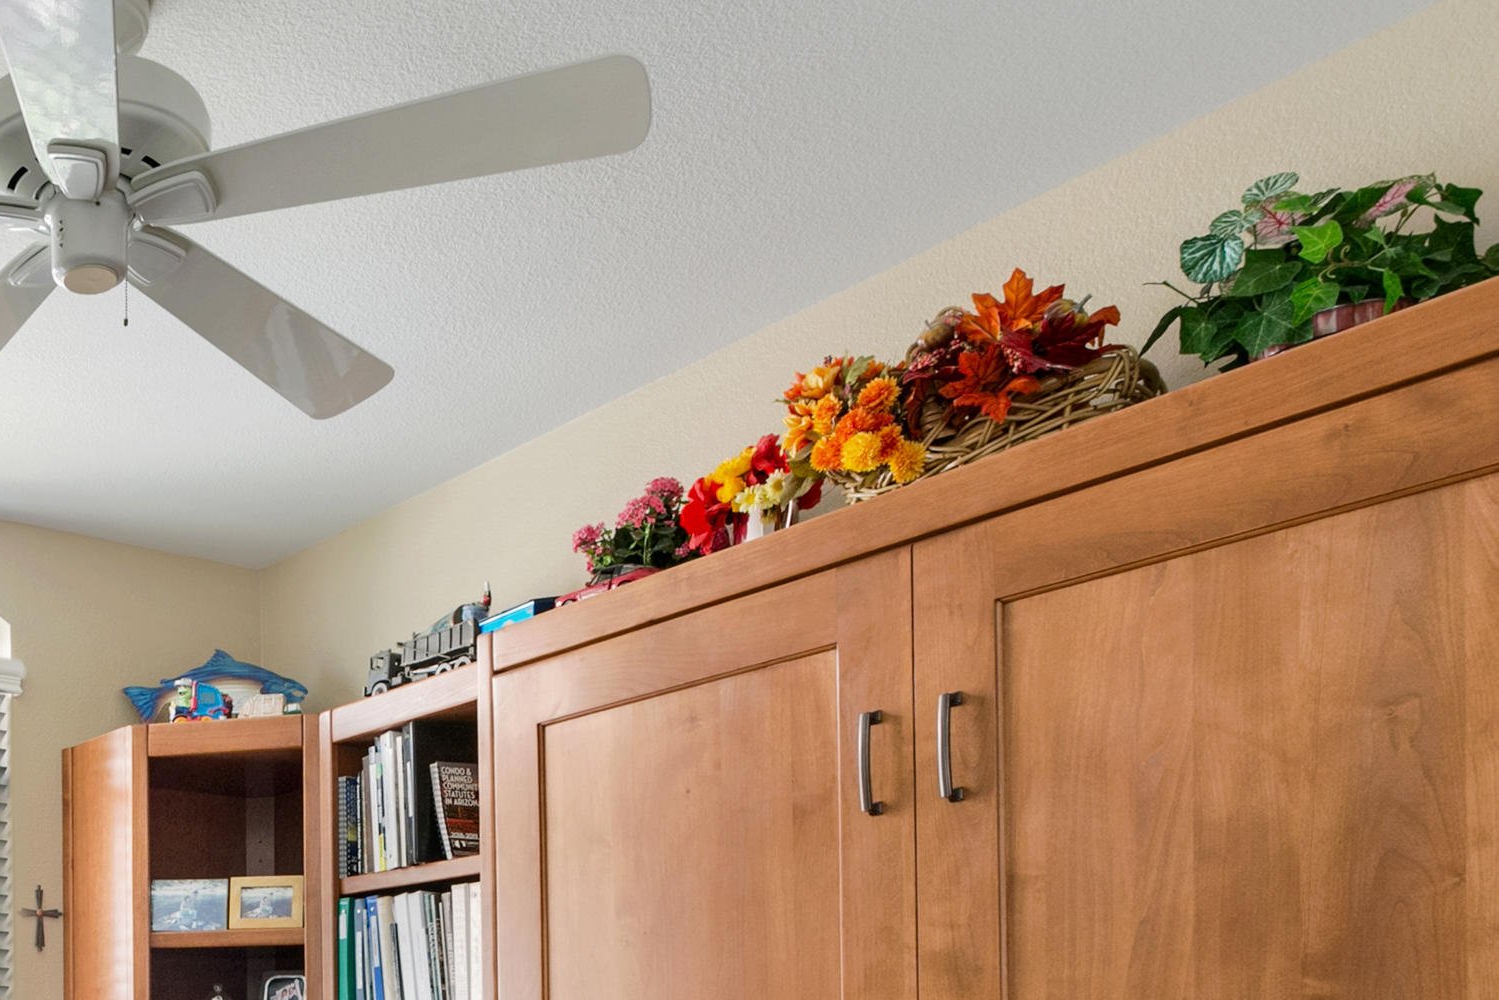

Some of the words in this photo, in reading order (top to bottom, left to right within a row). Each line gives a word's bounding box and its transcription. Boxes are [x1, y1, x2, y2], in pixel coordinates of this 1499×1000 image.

[441, 767, 465, 775] CONDO
[442, 775, 473, 783] PLANNED
[444, 790, 475, 798] STATUTES
